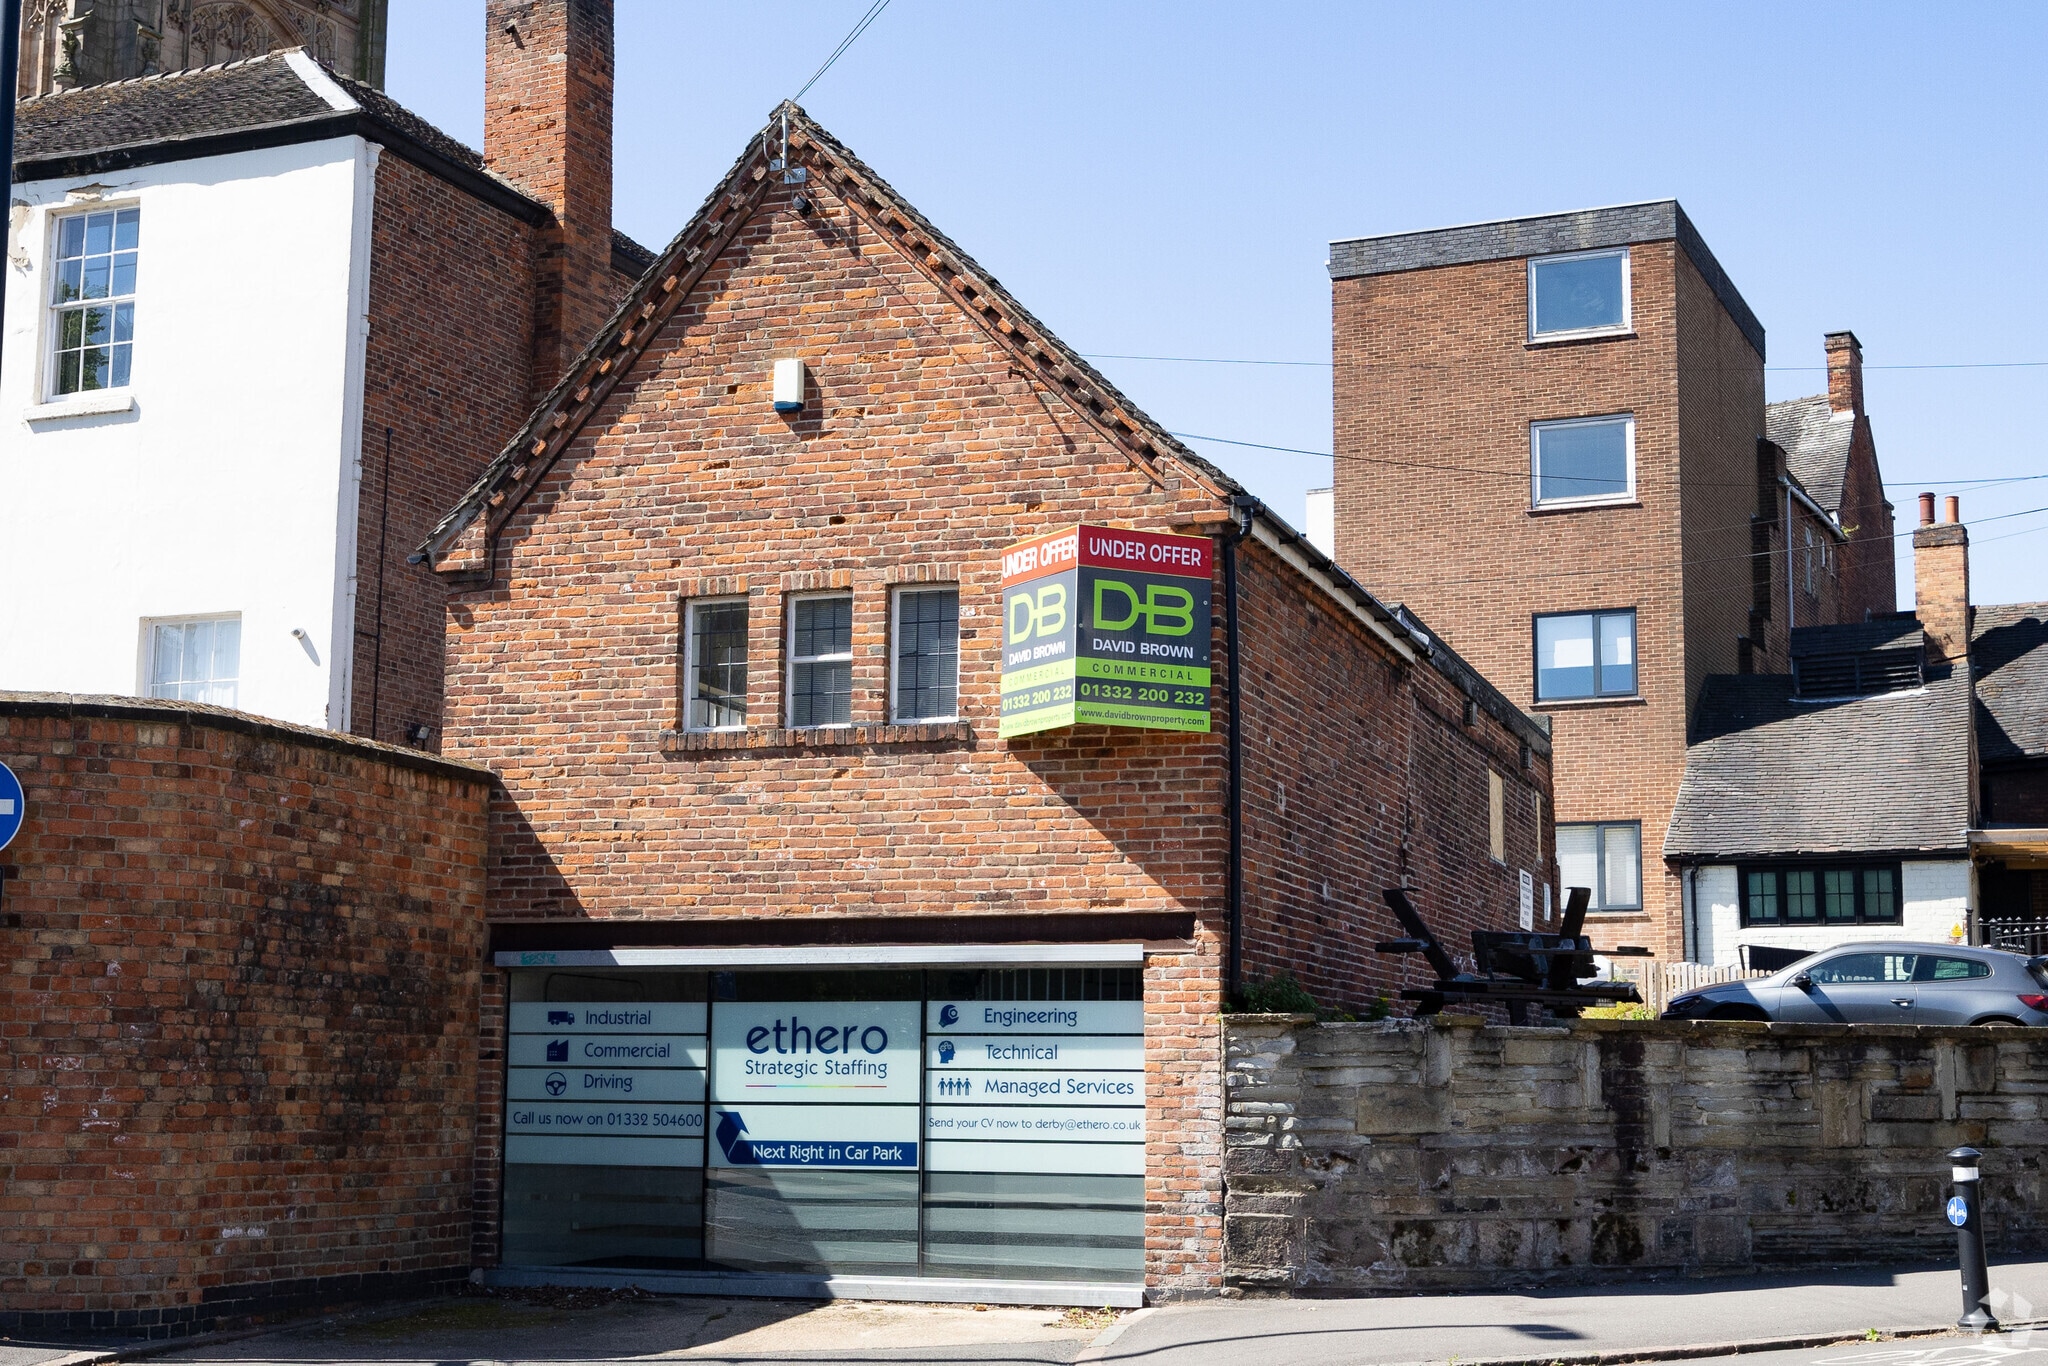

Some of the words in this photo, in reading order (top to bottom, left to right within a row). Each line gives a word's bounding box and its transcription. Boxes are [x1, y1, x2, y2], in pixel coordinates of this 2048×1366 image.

[1003, 547, 1037, 578] UNDER
[1040, 536, 1077, 565] OFFER
[1089, 537, 1145, 560] UNDER
[1150, 544, 1201, 566] OFFER
[1009, 650, 1031, 666] DAVID
[1033, 641, 1065, 660] BROWN
[1093, 639, 1135, 654] DAVID
[1141, 643, 1193, 658] BROWN
[1008, 664, 1065, 687] COMMERCIAL
[1092, 663, 1192, 680] COMMERCIAL
[1002, 694, 1029, 711] 01332
[1033, 689, 1050, 706] 200
[1054, 685, 1071, 701] 232
[1081, 683, 1132, 700] 01332
[1138, 688, 1168, 703] 200
[1174, 691, 1204, 705] 232
[1081, 709, 1205, 726] www.davidbrownproperty.com
[586, 1010, 651, 1025] Industrial
[984, 1008, 1077, 1027] Engineering
[746, 1016, 888, 1054] ethero
[584, 1043, 670, 1058] Commercial
[985, 1045, 1058, 1060] Technical
[745, 1060, 818, 1078] Strategic
[825, 1060, 887, 1078] Staffing
[584, 1074, 633, 1092] Driving
[984, 1079, 1060, 1097] Managed
[1067, 1079, 1134, 1094] Services
[513, 1112, 534, 1124] Call
[539, 1116, 551, 1124] us
[556, 1115, 583, 1125] now
[587, 1115, 603, 1125] on
[607, 1113, 648, 1126] 01332
[653, 1114, 702, 1126] 504600
[929, 1118, 953, 1128] Send
[957, 1120, 978, 1129] your
[981, 1119, 993, 1128] CV
[997, 1120, 1018, 1128] now
[1021, 1120, 1032, 1129] to
[1035, 1119, 1140, 1131] derby@ethero.co.uk
[753, 1145, 785, 1158] Next
[789, 1145, 824, 1162] Right
[829, 1145, 841, 1159] in
[845, 1146, 868, 1160] Car
[873, 1146, 902, 1160] Park
